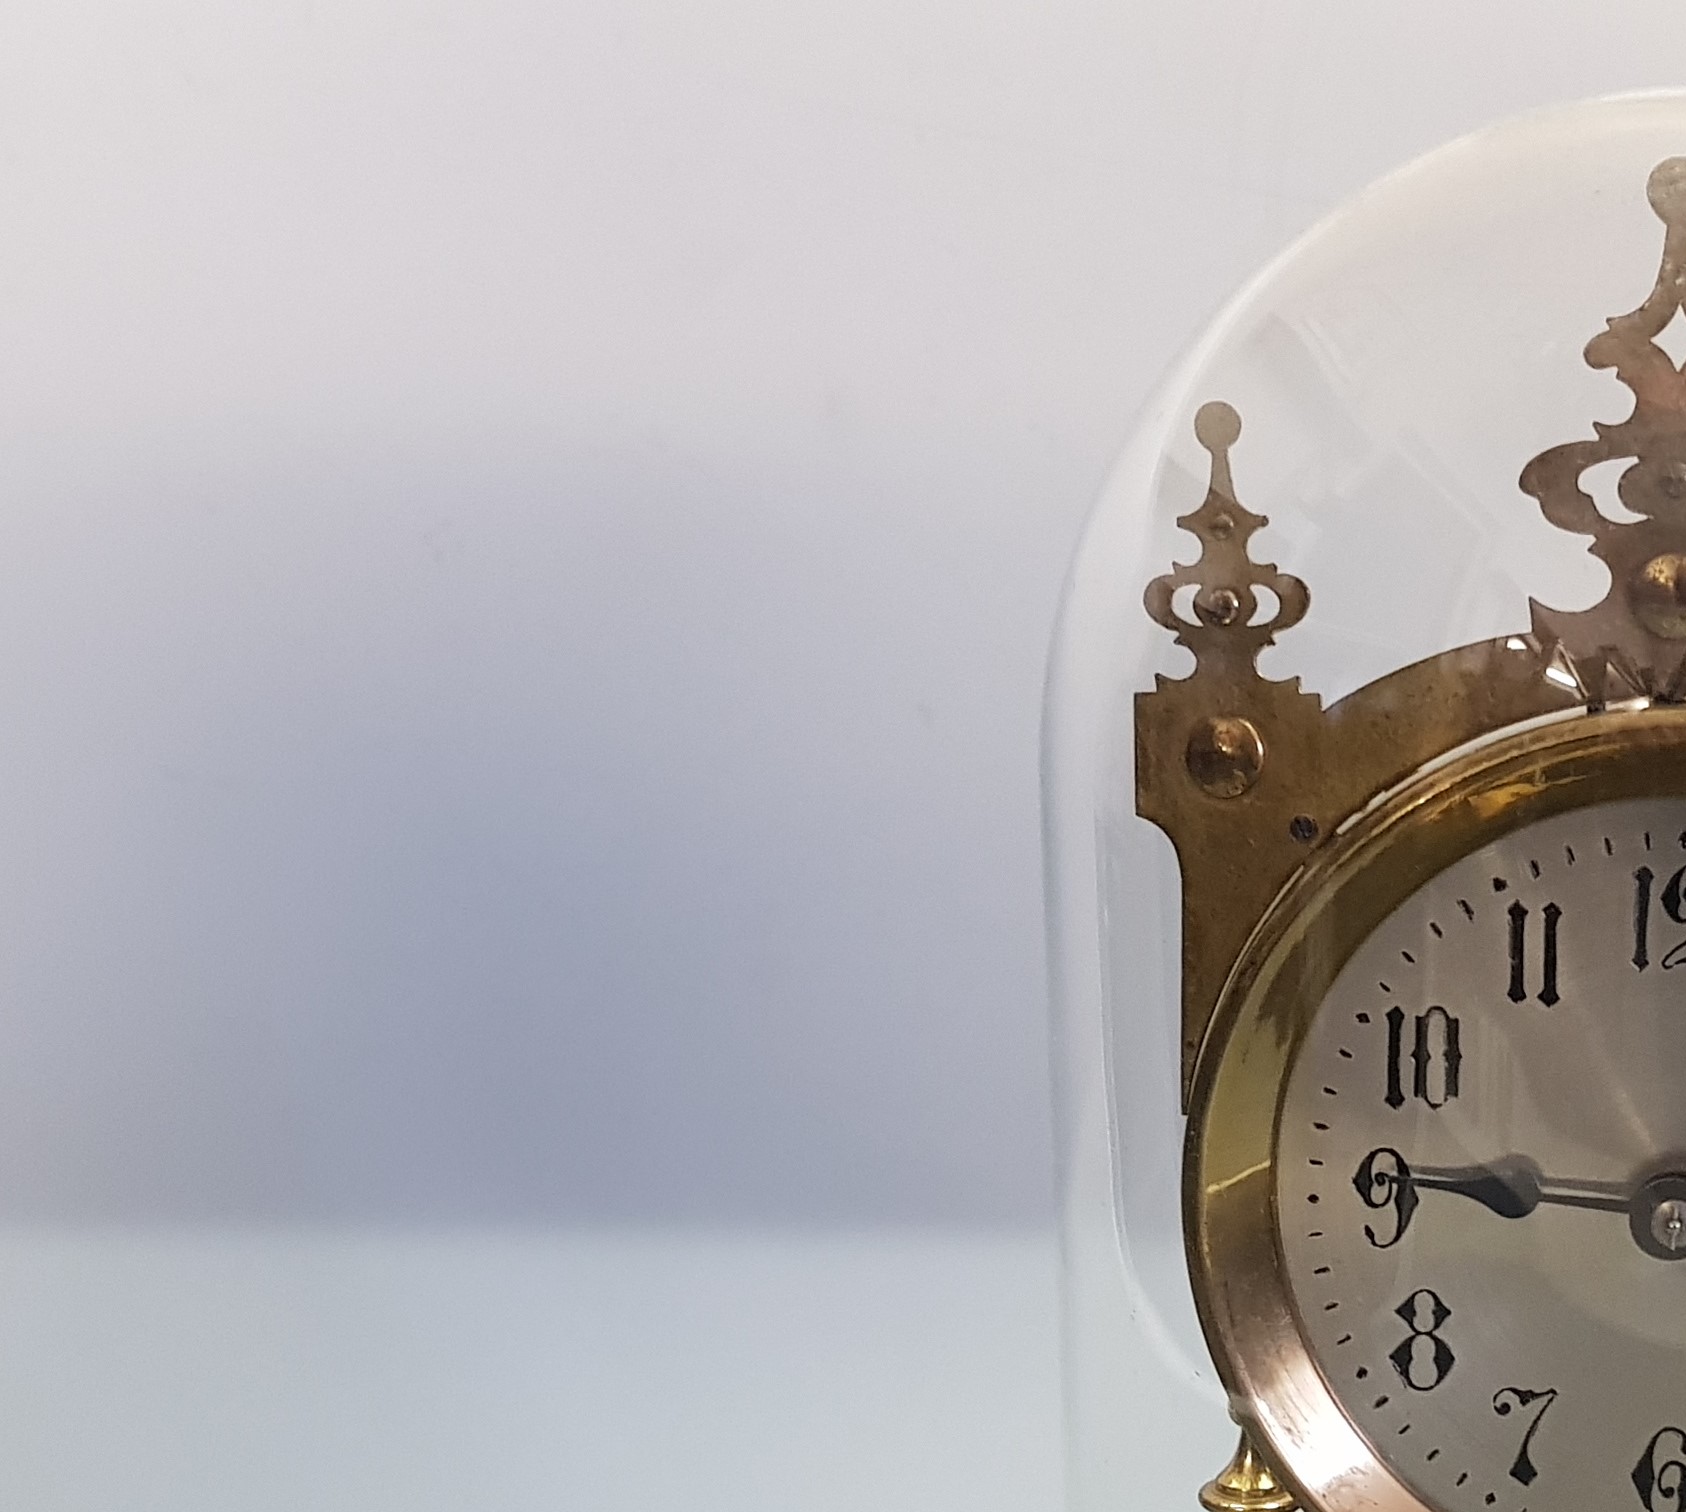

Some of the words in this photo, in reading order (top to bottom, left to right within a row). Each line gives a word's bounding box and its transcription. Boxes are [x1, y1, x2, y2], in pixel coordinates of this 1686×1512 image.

[1507, 900, 1563, 1007] 11
[1385, 1005, 1463, 1110] 10
[1352, 1147, 1419, 1249] 9
[1388, 1288, 1457, 1392] 8
[1492, 1387, 1559, 1487] 7
